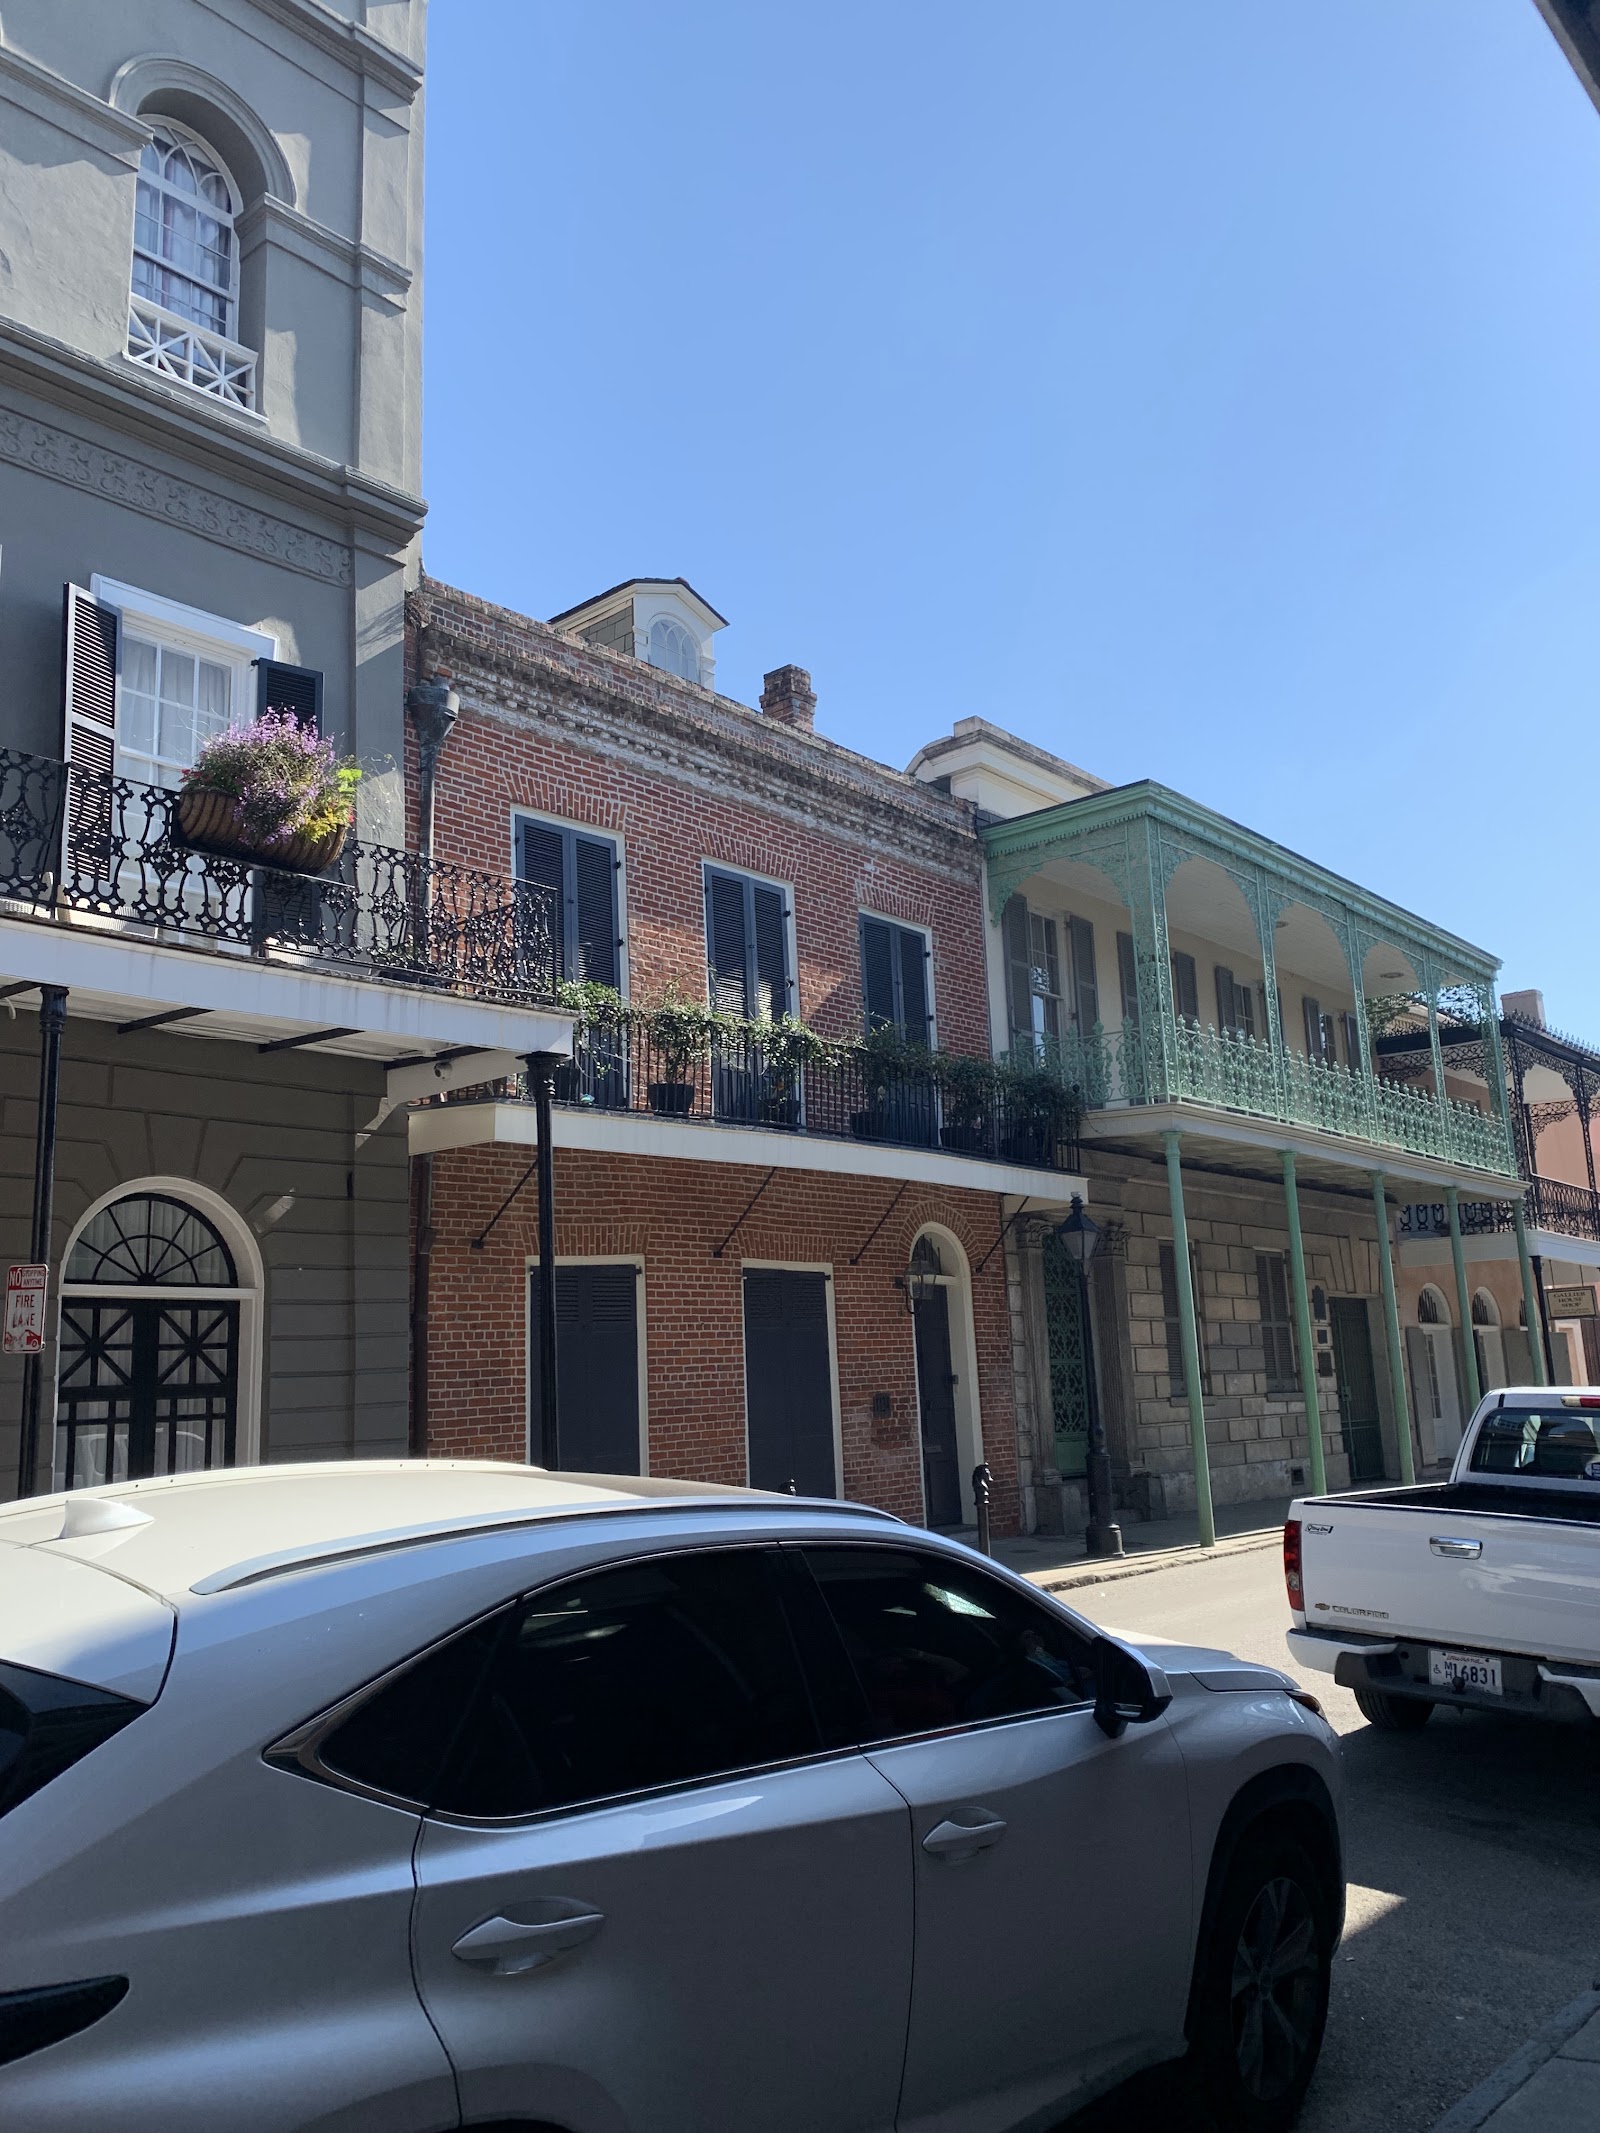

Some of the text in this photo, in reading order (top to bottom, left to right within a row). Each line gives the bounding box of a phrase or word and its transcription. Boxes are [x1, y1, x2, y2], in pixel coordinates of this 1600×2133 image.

[9, 1268, 21, 1287] NO
[22, 1269, 45, 1278] STOPPING
[23, 1278, 43, 1287] ANYTIME
[15, 1294, 36, 1308] FIRE
[1332, 1605, 1390, 1620] COLORADO
